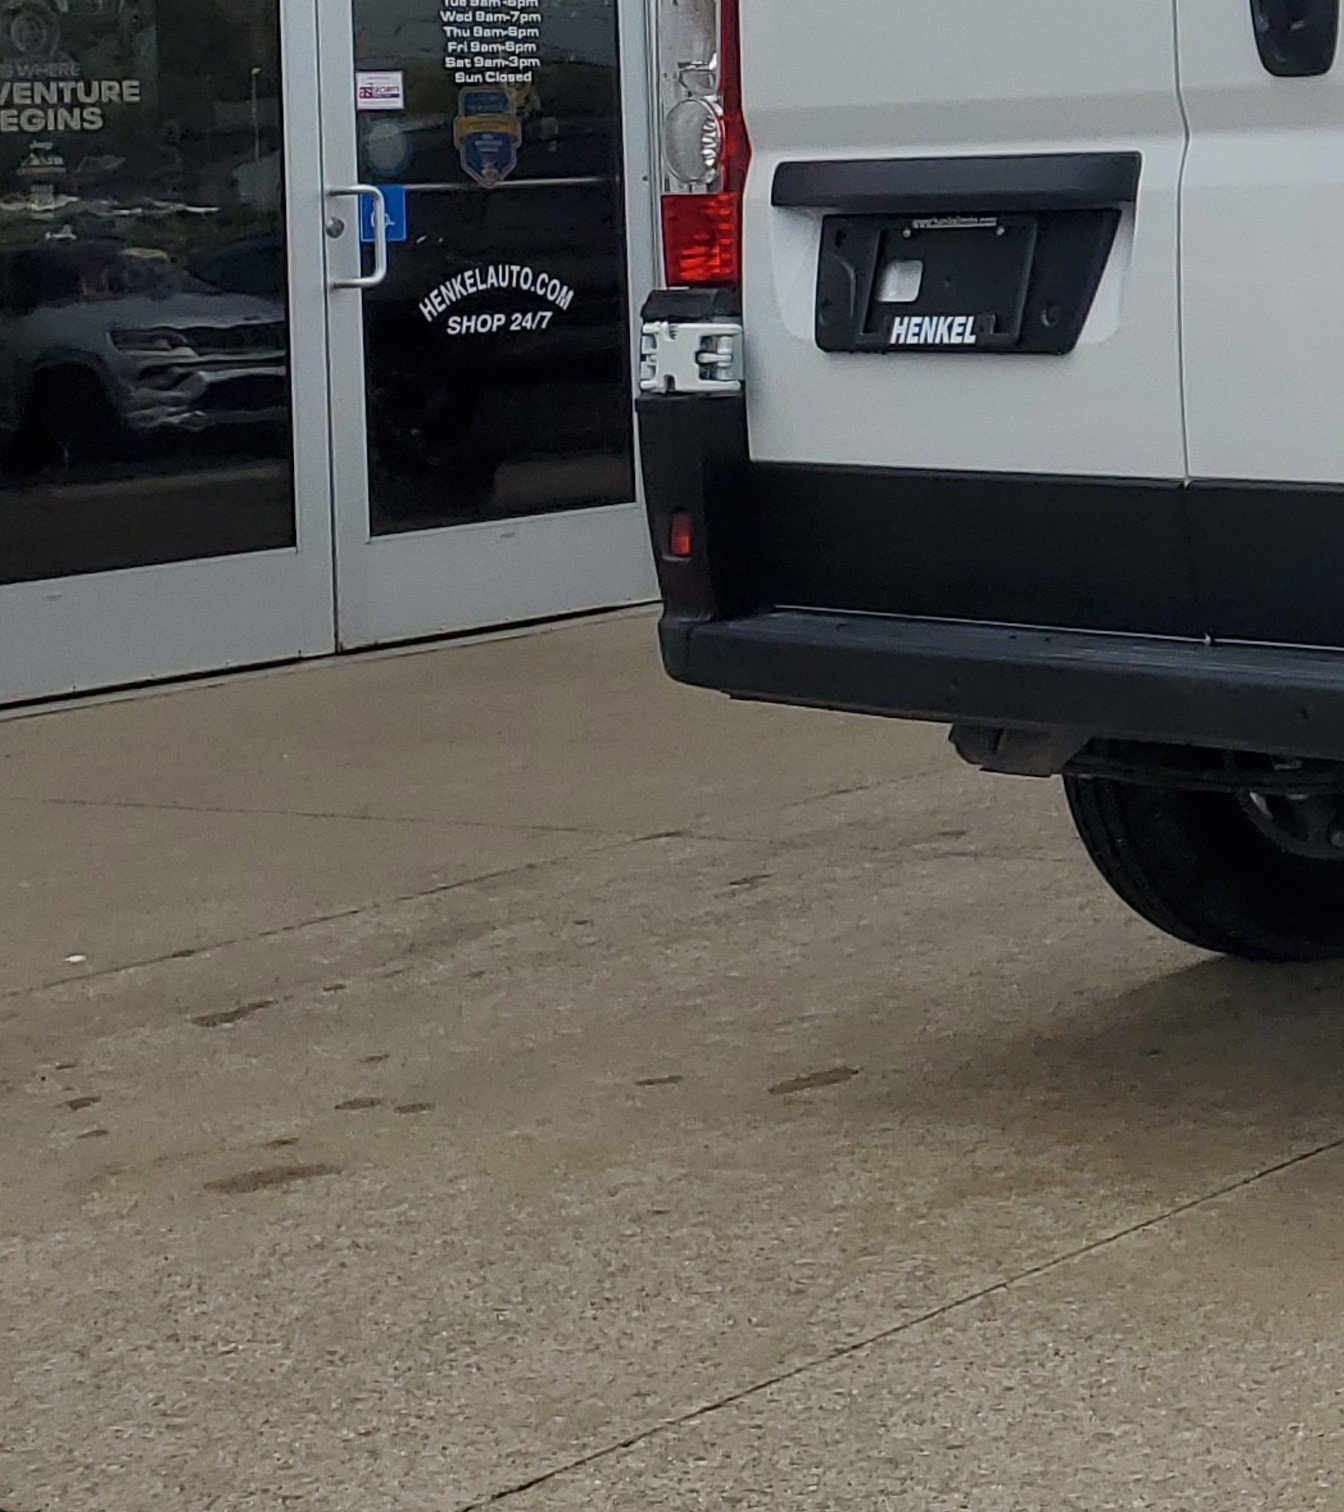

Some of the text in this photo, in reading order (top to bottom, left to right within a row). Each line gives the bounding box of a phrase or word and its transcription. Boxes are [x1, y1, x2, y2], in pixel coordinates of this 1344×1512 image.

[442, 26, 471, 38] Thu
[447, 41, 468, 53] Fri
[444, 55, 541, 70] Sat 9am-3pm
[454, 70, 533, 83] Sun Closed
[418, 263, 575, 323] HENKELAUTO.COM
[446, 311, 553, 335] SHOP 24/7
[889, 316, 978, 345] HENKEL
